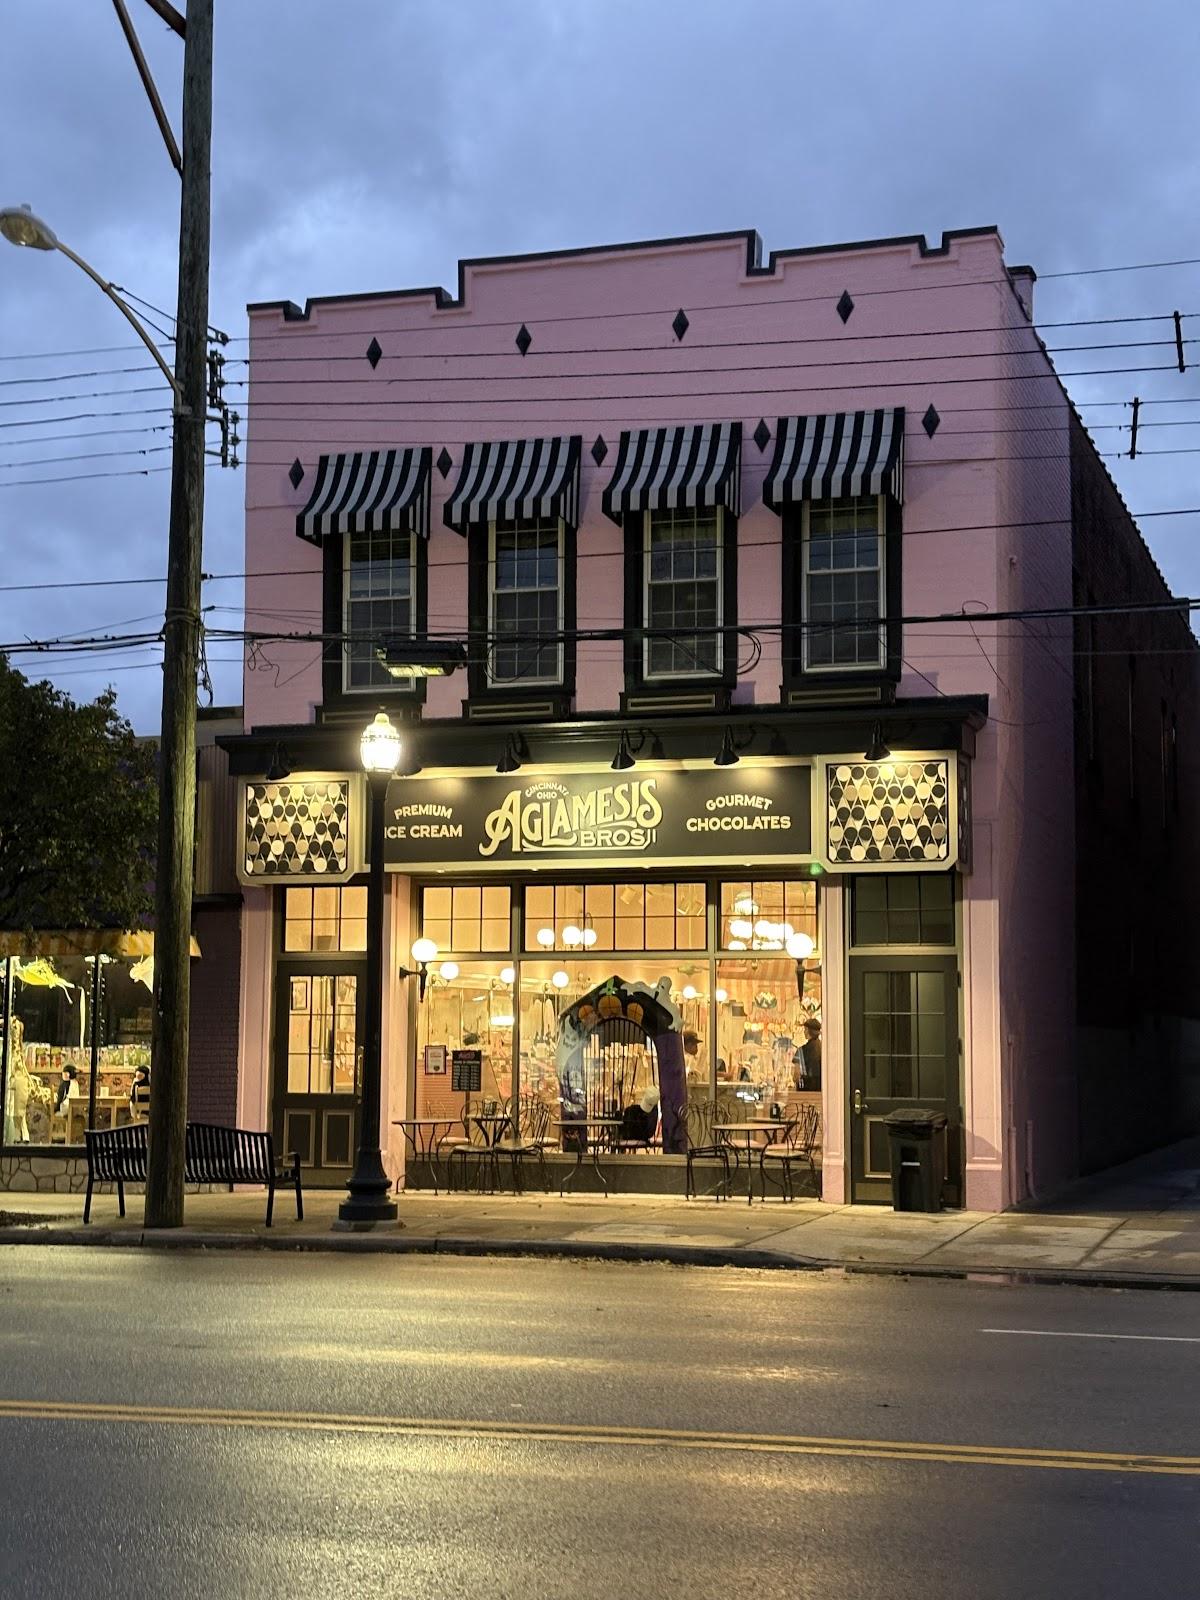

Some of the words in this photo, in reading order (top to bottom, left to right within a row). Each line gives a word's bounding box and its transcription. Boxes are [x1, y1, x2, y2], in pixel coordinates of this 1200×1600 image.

[536, 791, 558, 800] OHIO
[705, 793, 773, 811] GOURMET
[393, 804, 453, 820] PREMIUM
[478, 778, 663, 857] AGLAMESIS
[384, 825, 407, 839] ICE
[409, 824, 463, 838] CREAM
[686, 815, 792, 832] CHOCOLATES
[580, 828, 645, 847] BROS
